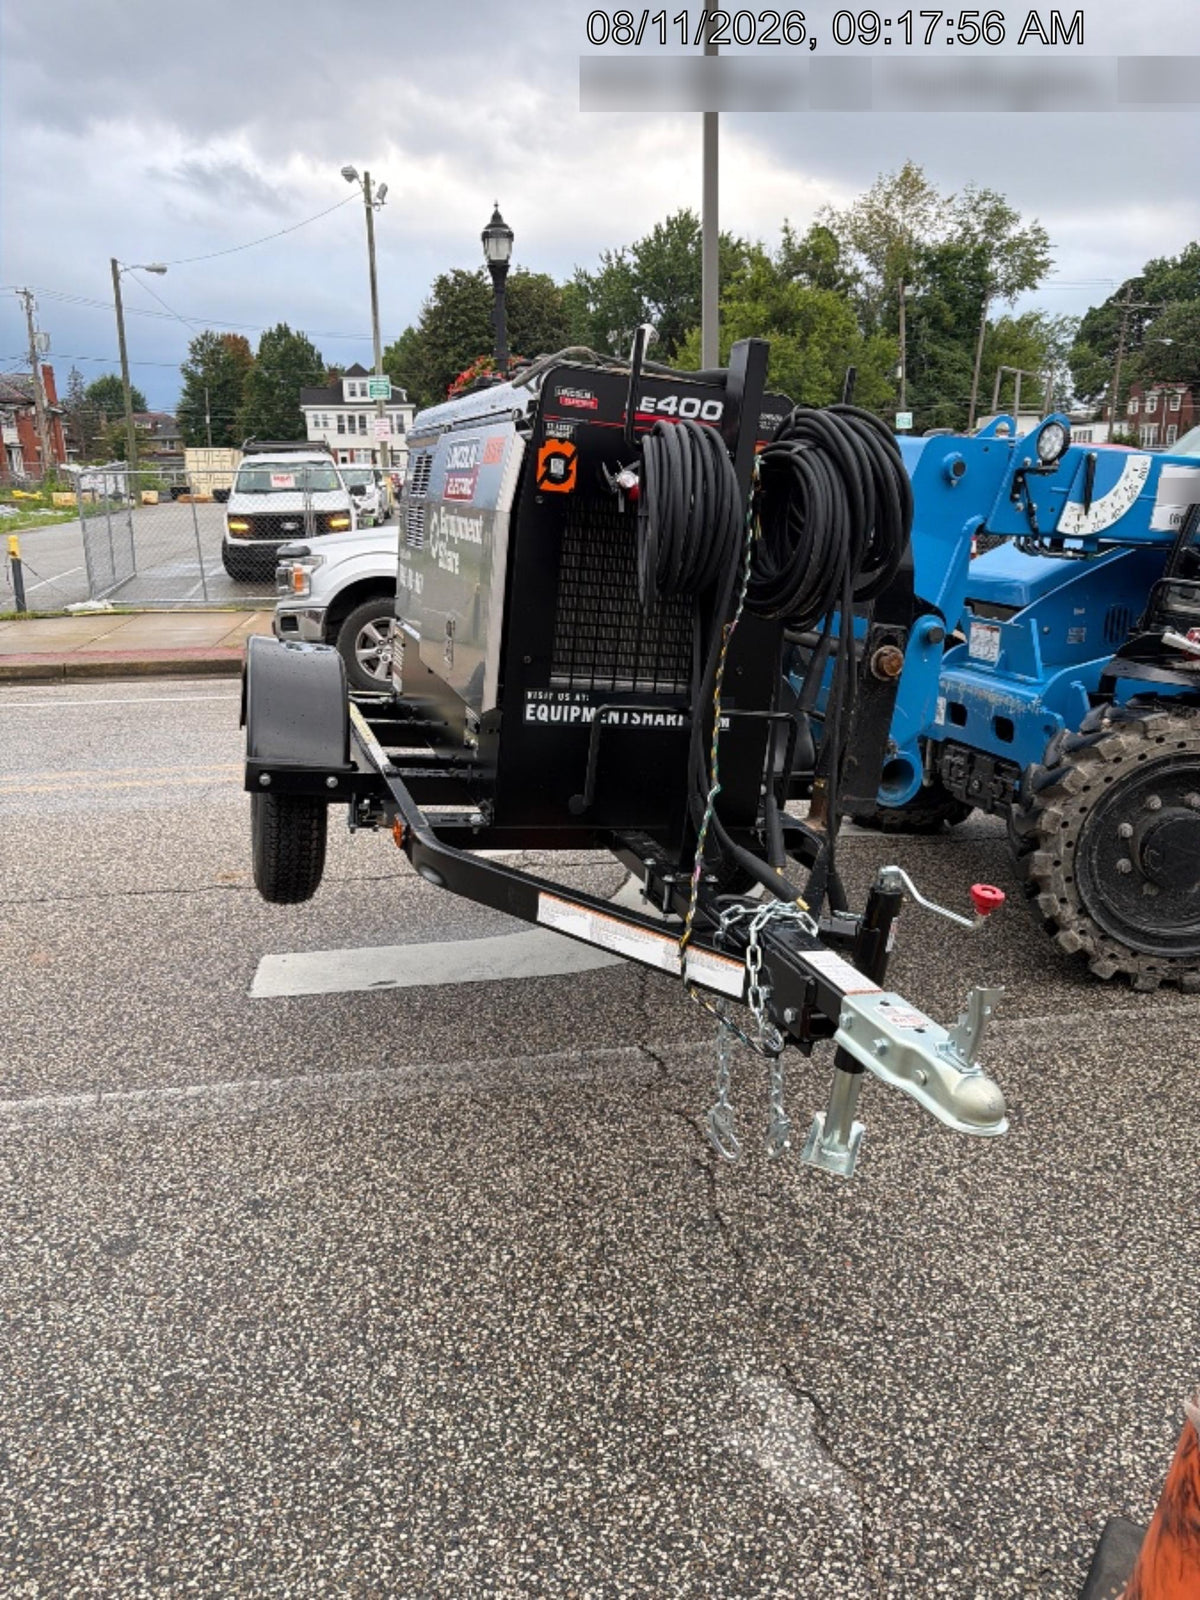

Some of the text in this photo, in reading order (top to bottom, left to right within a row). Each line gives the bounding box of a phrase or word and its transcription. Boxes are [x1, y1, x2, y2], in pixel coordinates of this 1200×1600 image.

[624, 395, 724, 421] E400
[440, 506, 483, 545] Equipment
[557, 693, 570, 701] US
